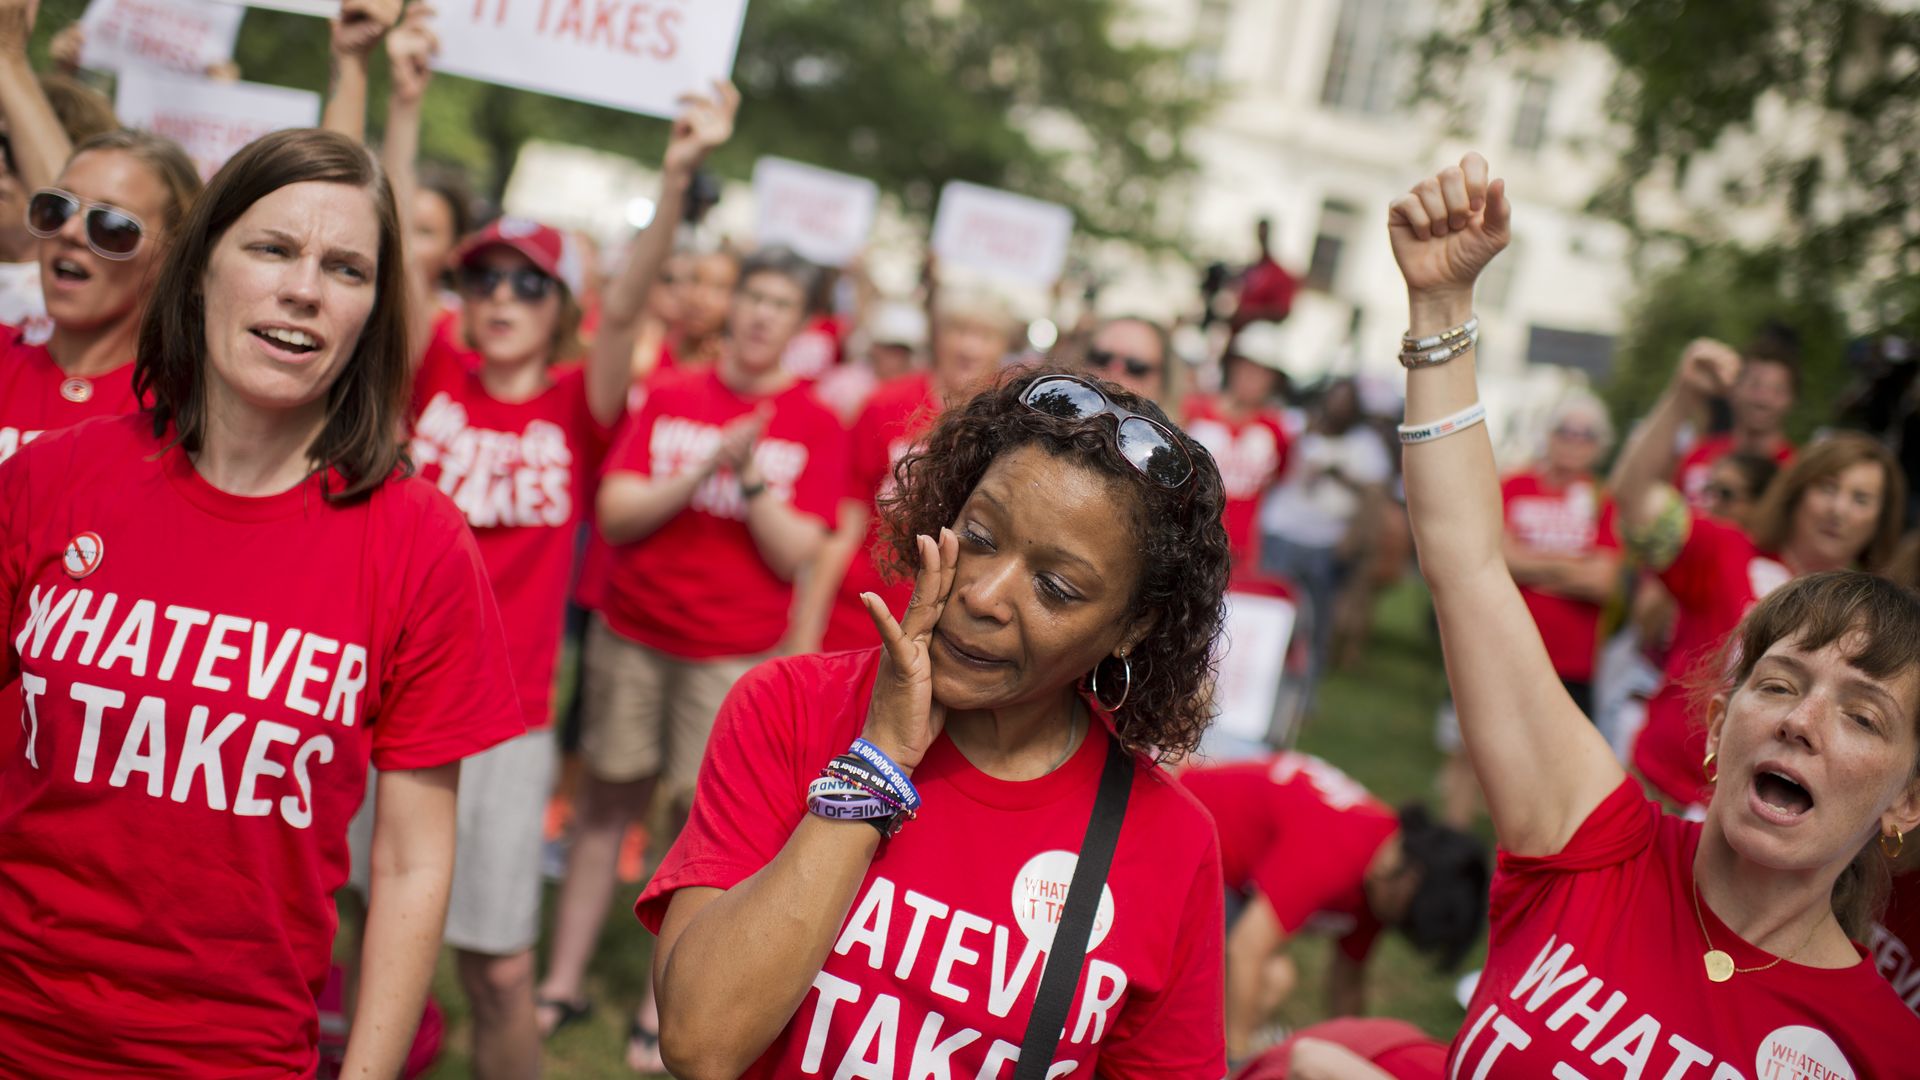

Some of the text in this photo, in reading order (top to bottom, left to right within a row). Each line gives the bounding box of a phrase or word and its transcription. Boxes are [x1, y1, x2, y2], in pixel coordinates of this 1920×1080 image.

[1400, 430, 1431, 441] CTION
[15, 584, 368, 726] WHATEVER
[70, 682, 335, 829] TAKES
[840, 760, 870, 781] Rather
[870, 775, 887, 789] Me
[1024, 876, 1067, 900] WHAT
[834, 876, 1128, 1045] ATEVR
